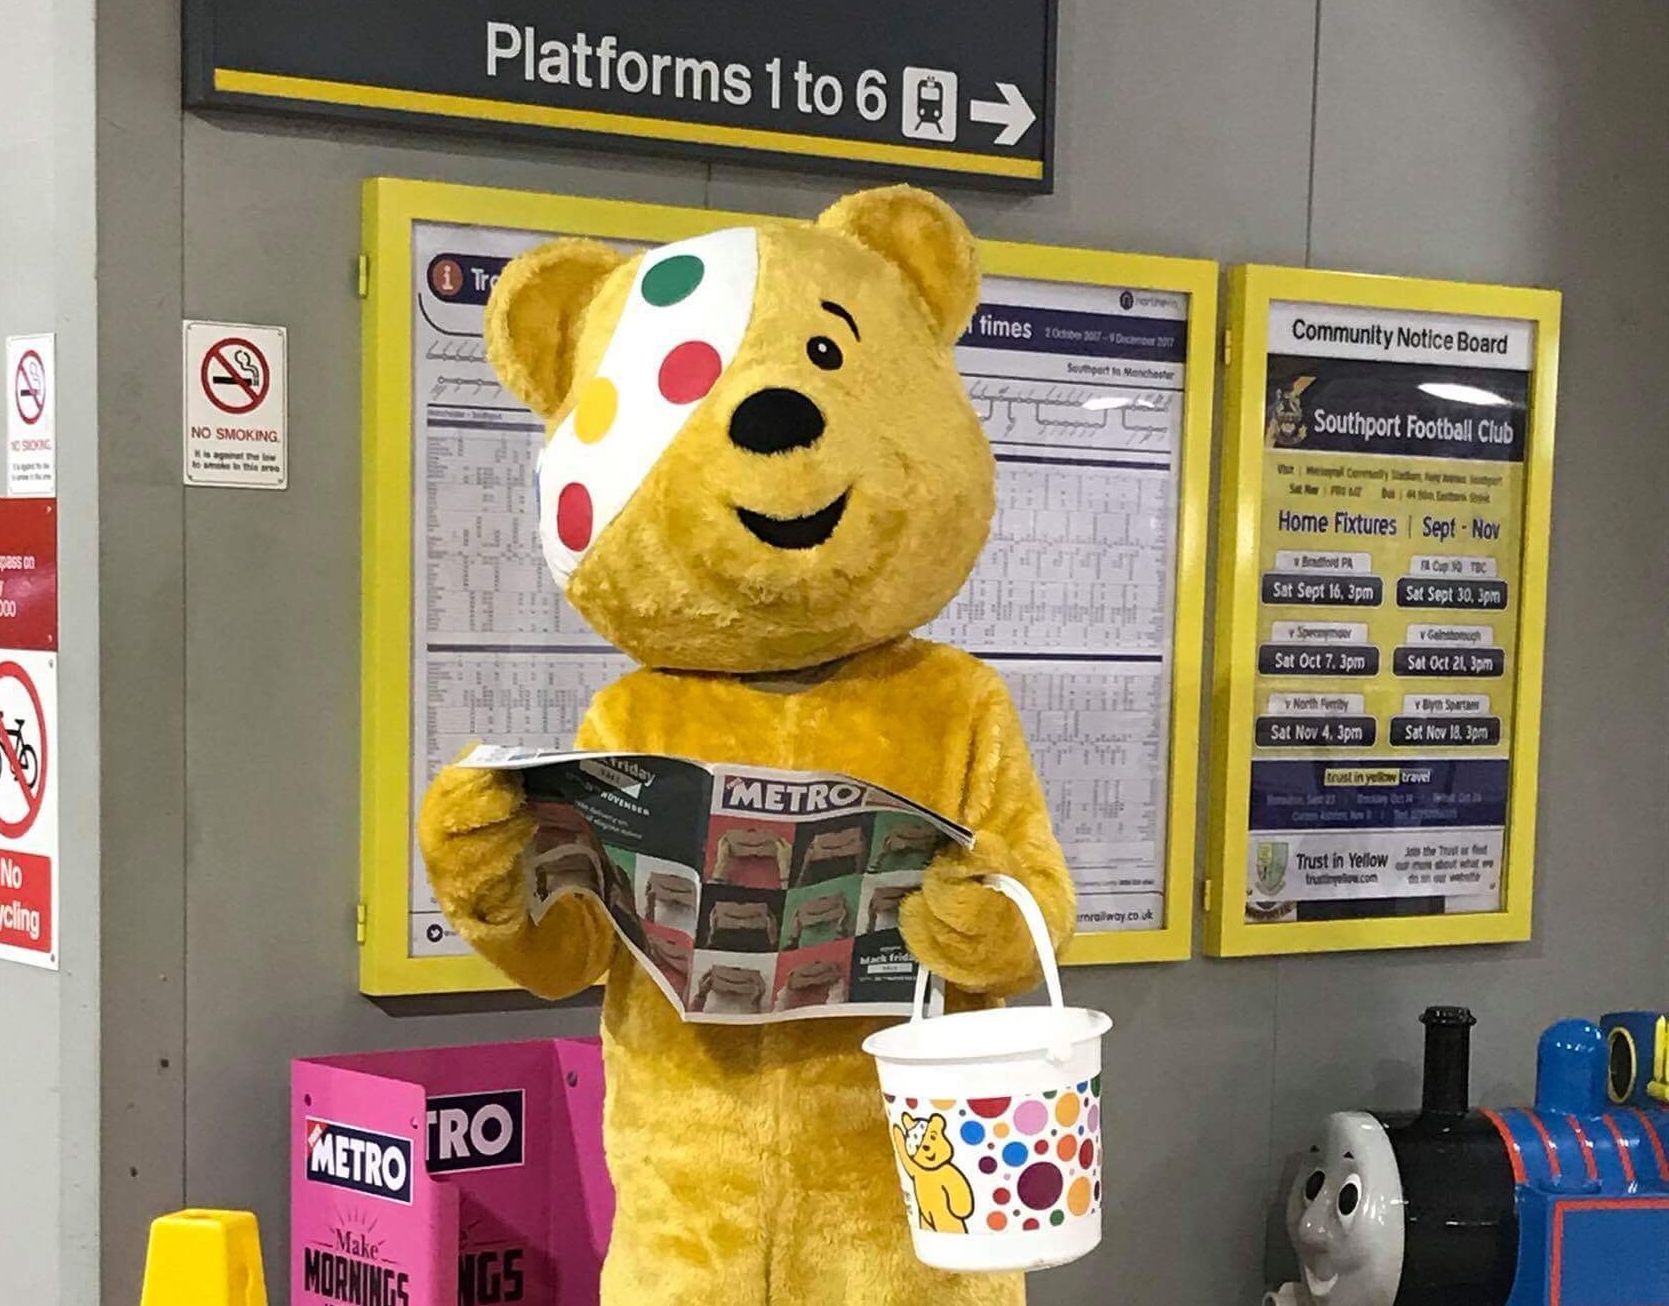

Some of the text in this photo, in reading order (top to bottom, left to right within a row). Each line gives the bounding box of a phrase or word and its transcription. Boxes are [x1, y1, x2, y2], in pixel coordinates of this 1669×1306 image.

[486, 21, 887, 121] Platforms 1 to 6
[980, 314, 1032, 339] times
[1292, 318, 1508, 355] Community Notice Board
[1067, 362, 1110, 377] Southport
[1124, 367, 1175, 380] Manchester
[191, 427, 211, 440] NO
[1314, 409, 1514, 444] Southport Football Club
[247, 452, 259, 460] the
[1278, 510, 1329, 533] Home
[1335, 512, 1397, 536] Fixtures
[1422, 516, 1457, 542] Sept
[1472, 519, 1500, 540] Nov
[24, 556, 35, 570] on
[1273, 581, 1293, 598] Sat
[1297, 582, 1325, 602] Sept
[1347, 585, 1374, 602] 3pm
[1406, 585, 1424, 601] Sat
[1427, 586, 1453, 604] Sept
[1478, 588, 1501, 606] 3pm
[1275, 652, 1295, 669] Sat
[1300, 652, 1321, 669] Oct
[1340, 654, 1365, 673] 3pm
[1408, 655, 1426, 671] Sat
[1430, 655, 1449, 671] Oct
[1471, 655, 1493, 674] 3pm
[1271, 724, 1291, 740] Sat
[1296, 725, 1318, 740] Nov
[1337, 725, 1363, 743] 3pm
[1405, 725, 1423, 740] Sat
[1426, 725, 1447, 740] Nov
[1466, 725, 1488, 743] 3pm
[1327, 771, 1431, 785] trust in yellow travel
[729, 781, 861, 812] METRO
[1296, 852, 1388, 870] Trust in Yellow
[0, 857, 23, 889] No
[0, 900, 40, 940] ycling
[311, 1133, 407, 1192] METRO
[335, 1228, 379, 1260] Make
[304, 1247, 409, 1306] MORNINGS
